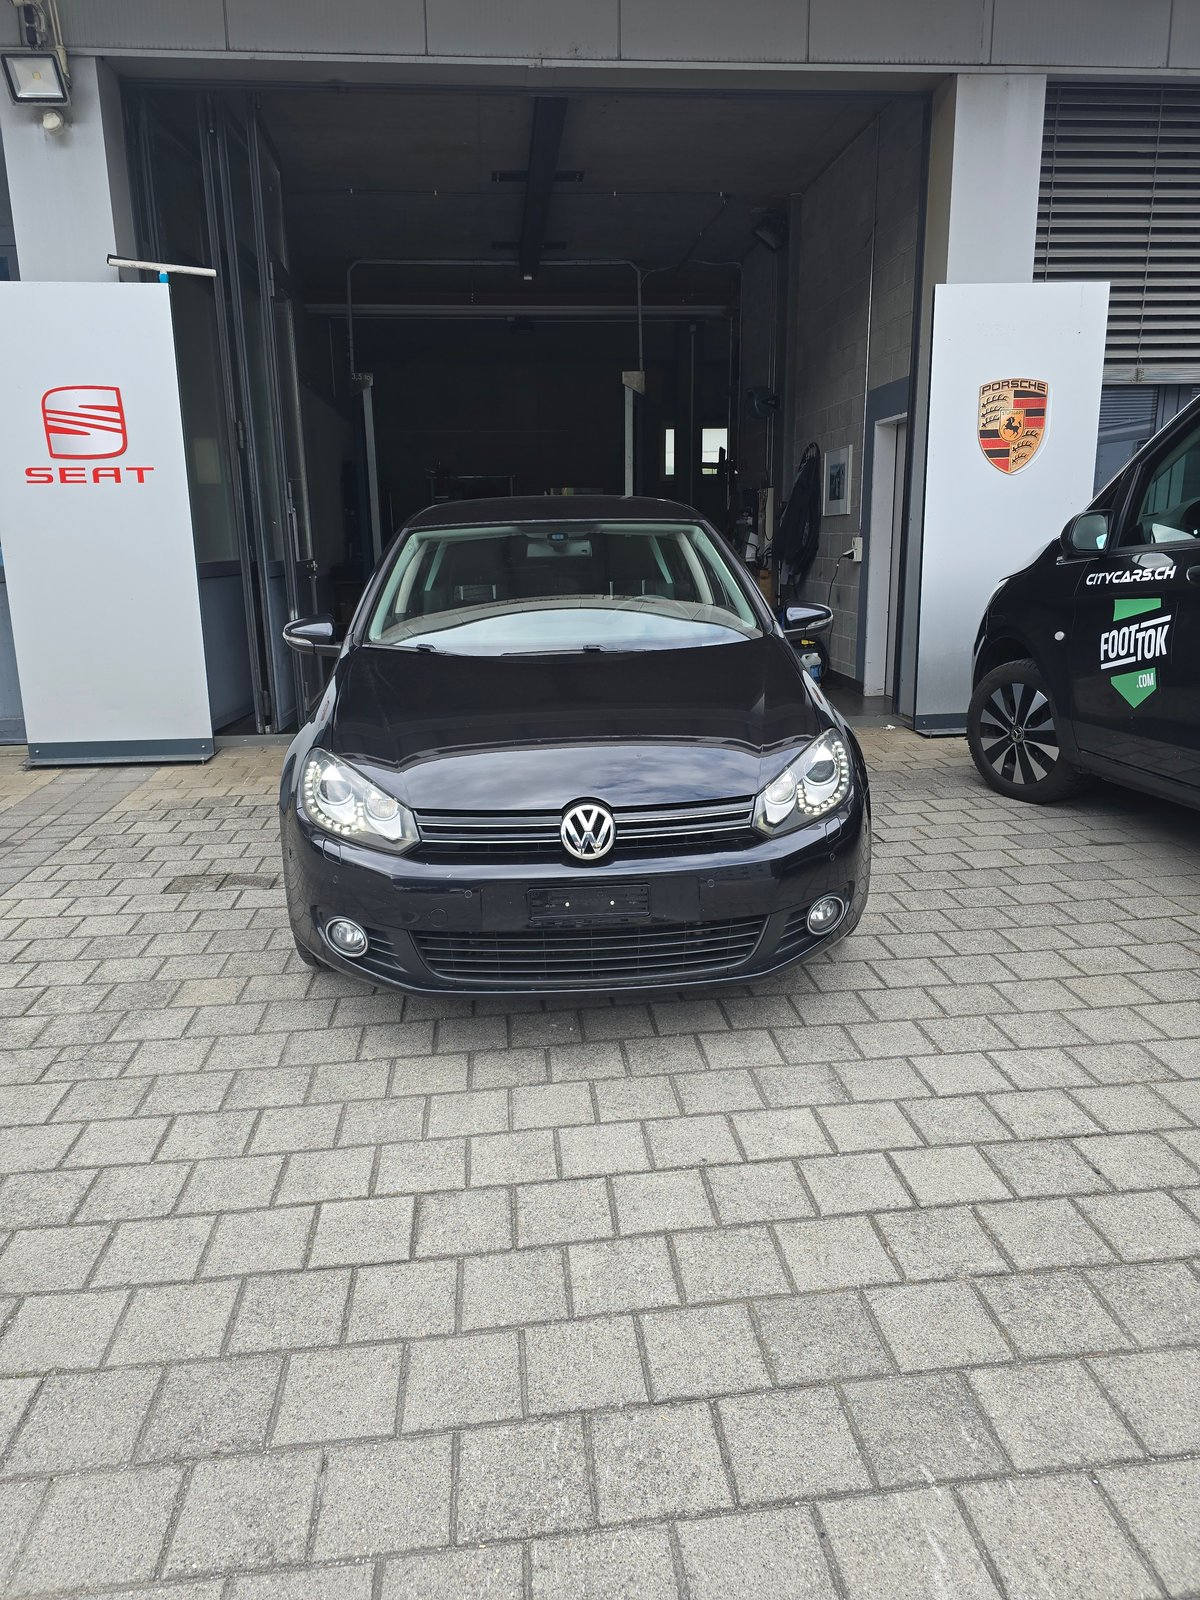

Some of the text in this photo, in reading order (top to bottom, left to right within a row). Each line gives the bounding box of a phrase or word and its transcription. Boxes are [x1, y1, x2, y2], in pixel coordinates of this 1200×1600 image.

[981, 380, 1046, 395] PORSCHE
[25, 467, 154, 484] SEAT
[1086, 566, 1177, 586] CITYCARS.CH
[1136, 672, 1155, 689] .COM
